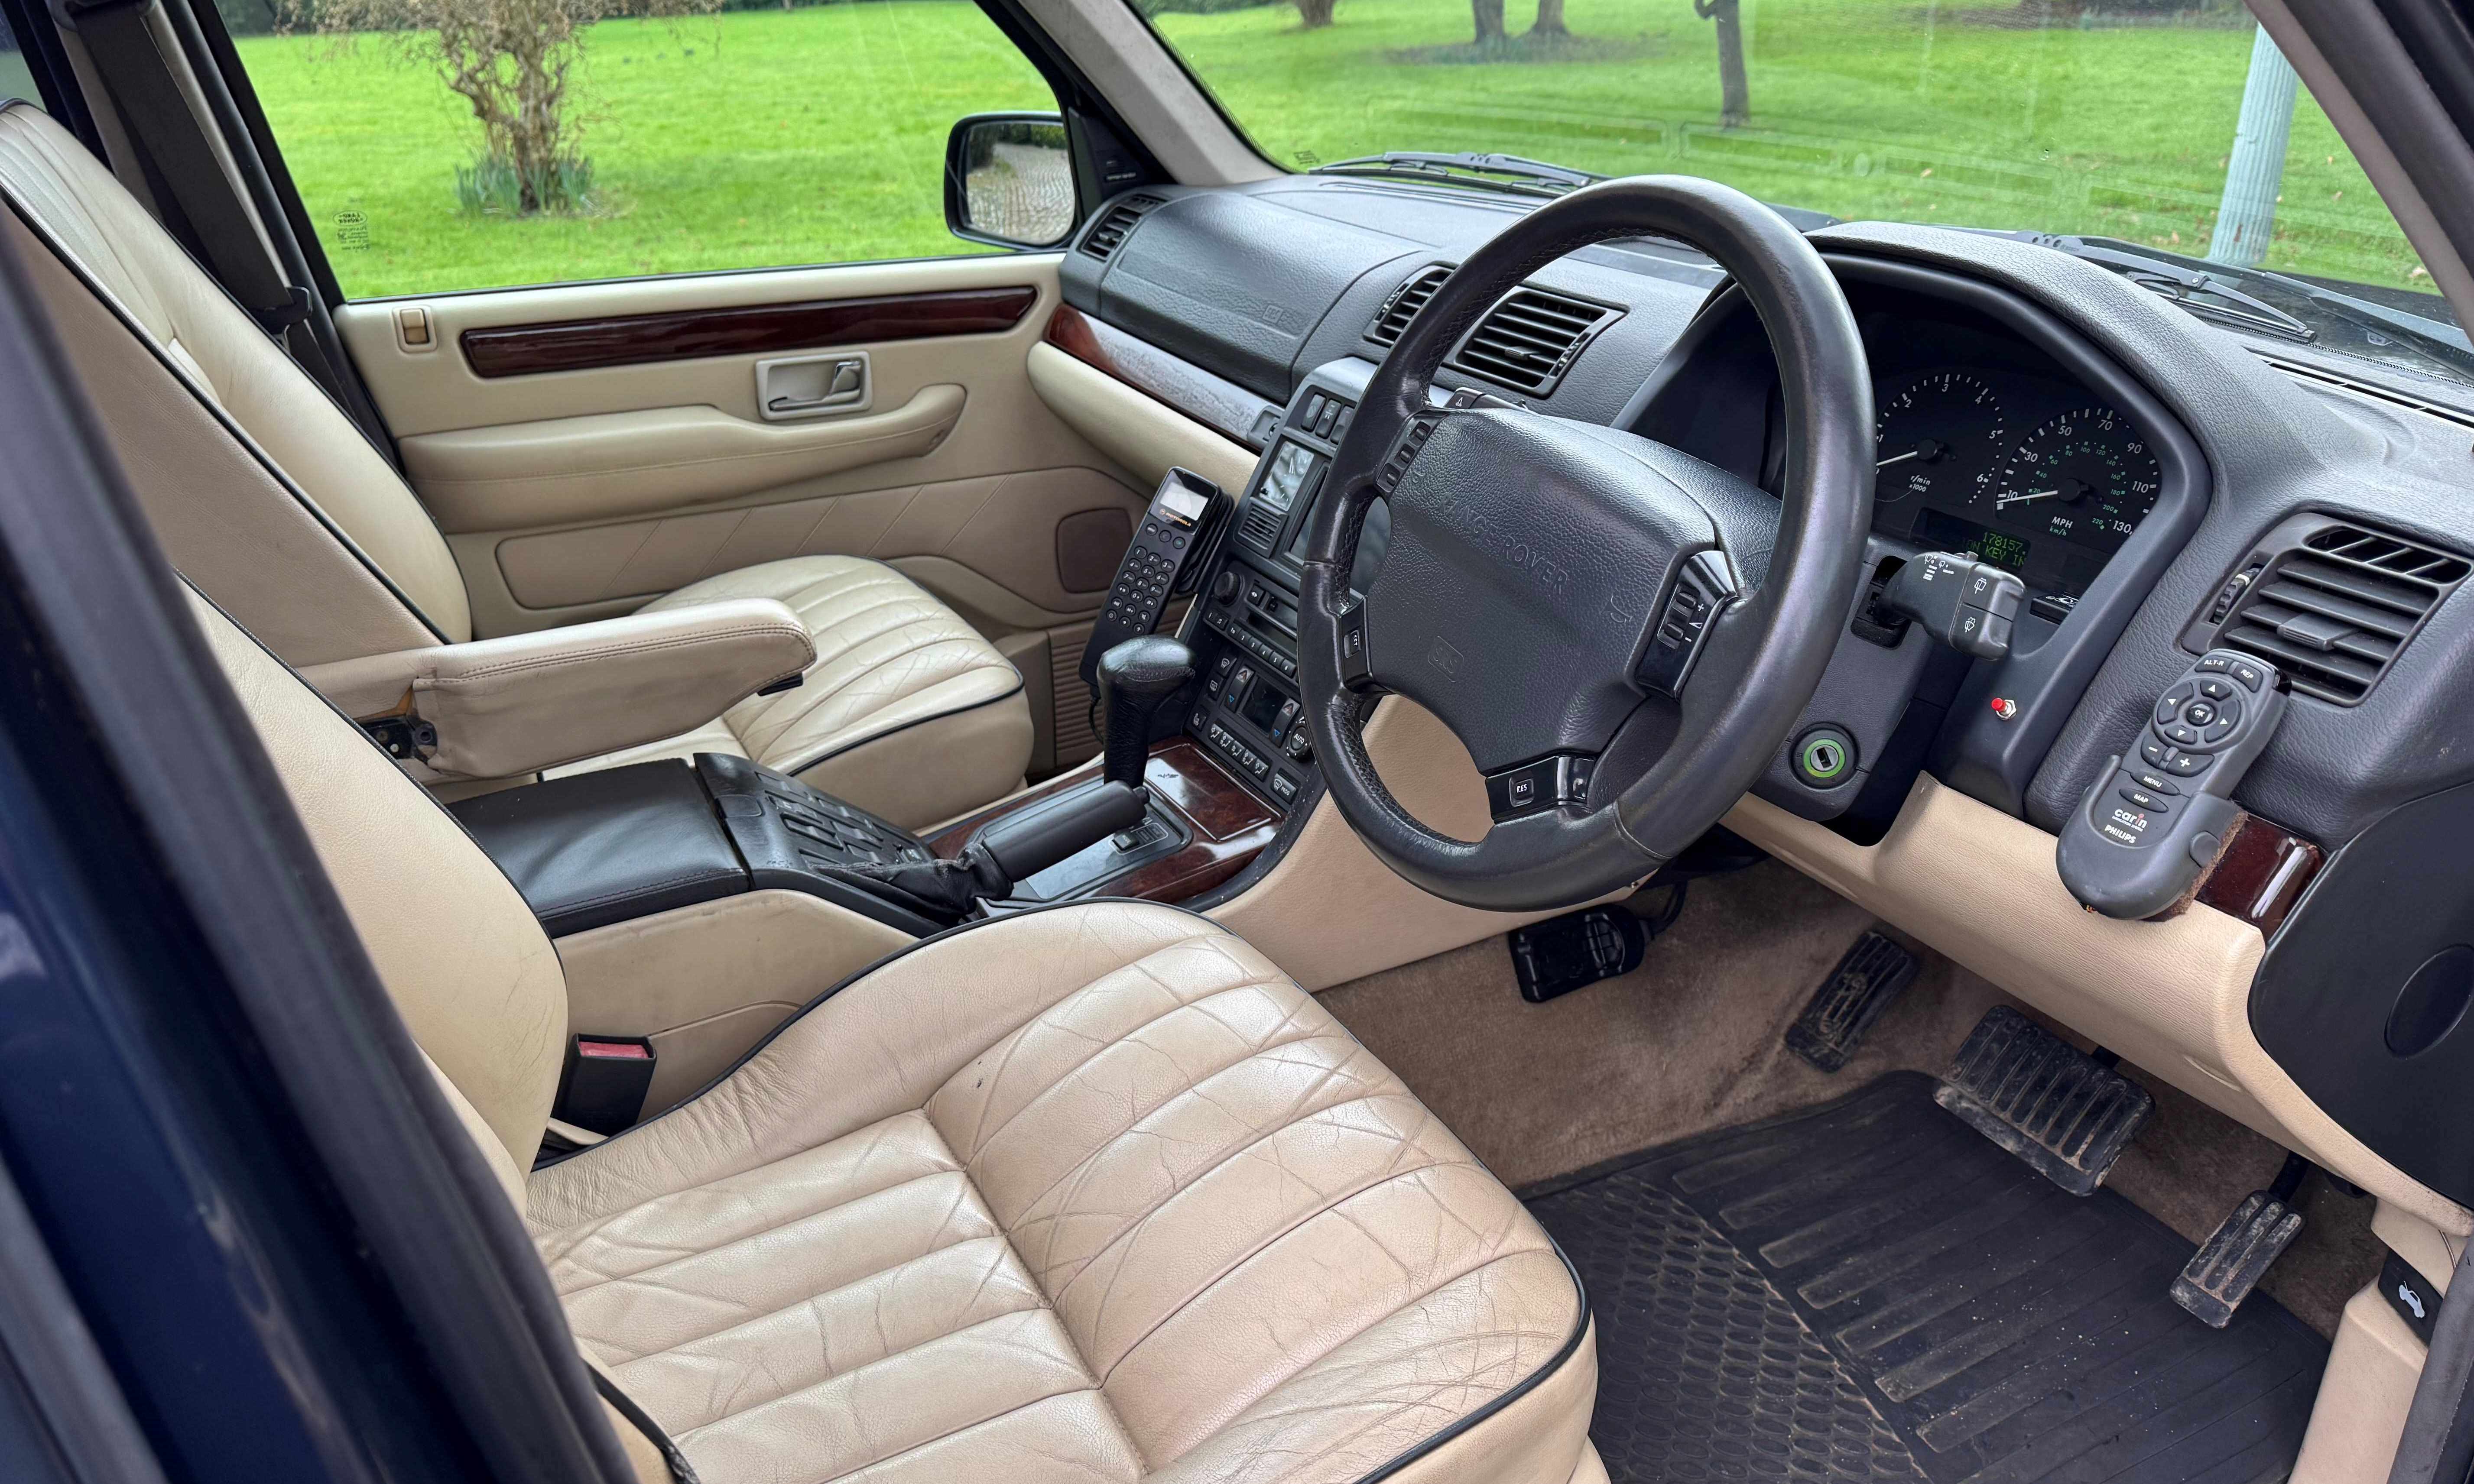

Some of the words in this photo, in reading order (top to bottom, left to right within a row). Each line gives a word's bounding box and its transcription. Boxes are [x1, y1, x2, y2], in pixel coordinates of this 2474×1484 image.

[1942, 384, 1949, 392] 3
[1905, 399, 1912, 408] 2
[1975, 395, 1982, 404] 4
[2058, 425, 2072, 436] 50
[2098, 419, 2113, 431] 70
[1989, 430, 1996, 439] 5
[2127, 442, 2142, 454] 90
[2024, 451, 2038, 462] 30
[1910, 475, 1931, 485] r/min
[1977, 473, 1984, 482] 6
[2132, 481, 2149, 493] 110
[2007, 489, 2018, 500] 10
[2052, 516, 2073, 528] MPH
[2113, 520, 2132, 534] 130
[2049, 526, 2067, 536] km/h
[1985, 546, 2007, 561] KEY
[1500, 534, 1568, 595] ROVER
[2240, 669, 2254, 678] REP
[1294, 733, 1305, 744] AUTO
[2143, 776, 2162, 787] MENU
[2133, 794, 2149, 803] MAP
[2114, 809, 2147, 829] carin
[2104, 824, 2136, 844] PHILIPS
